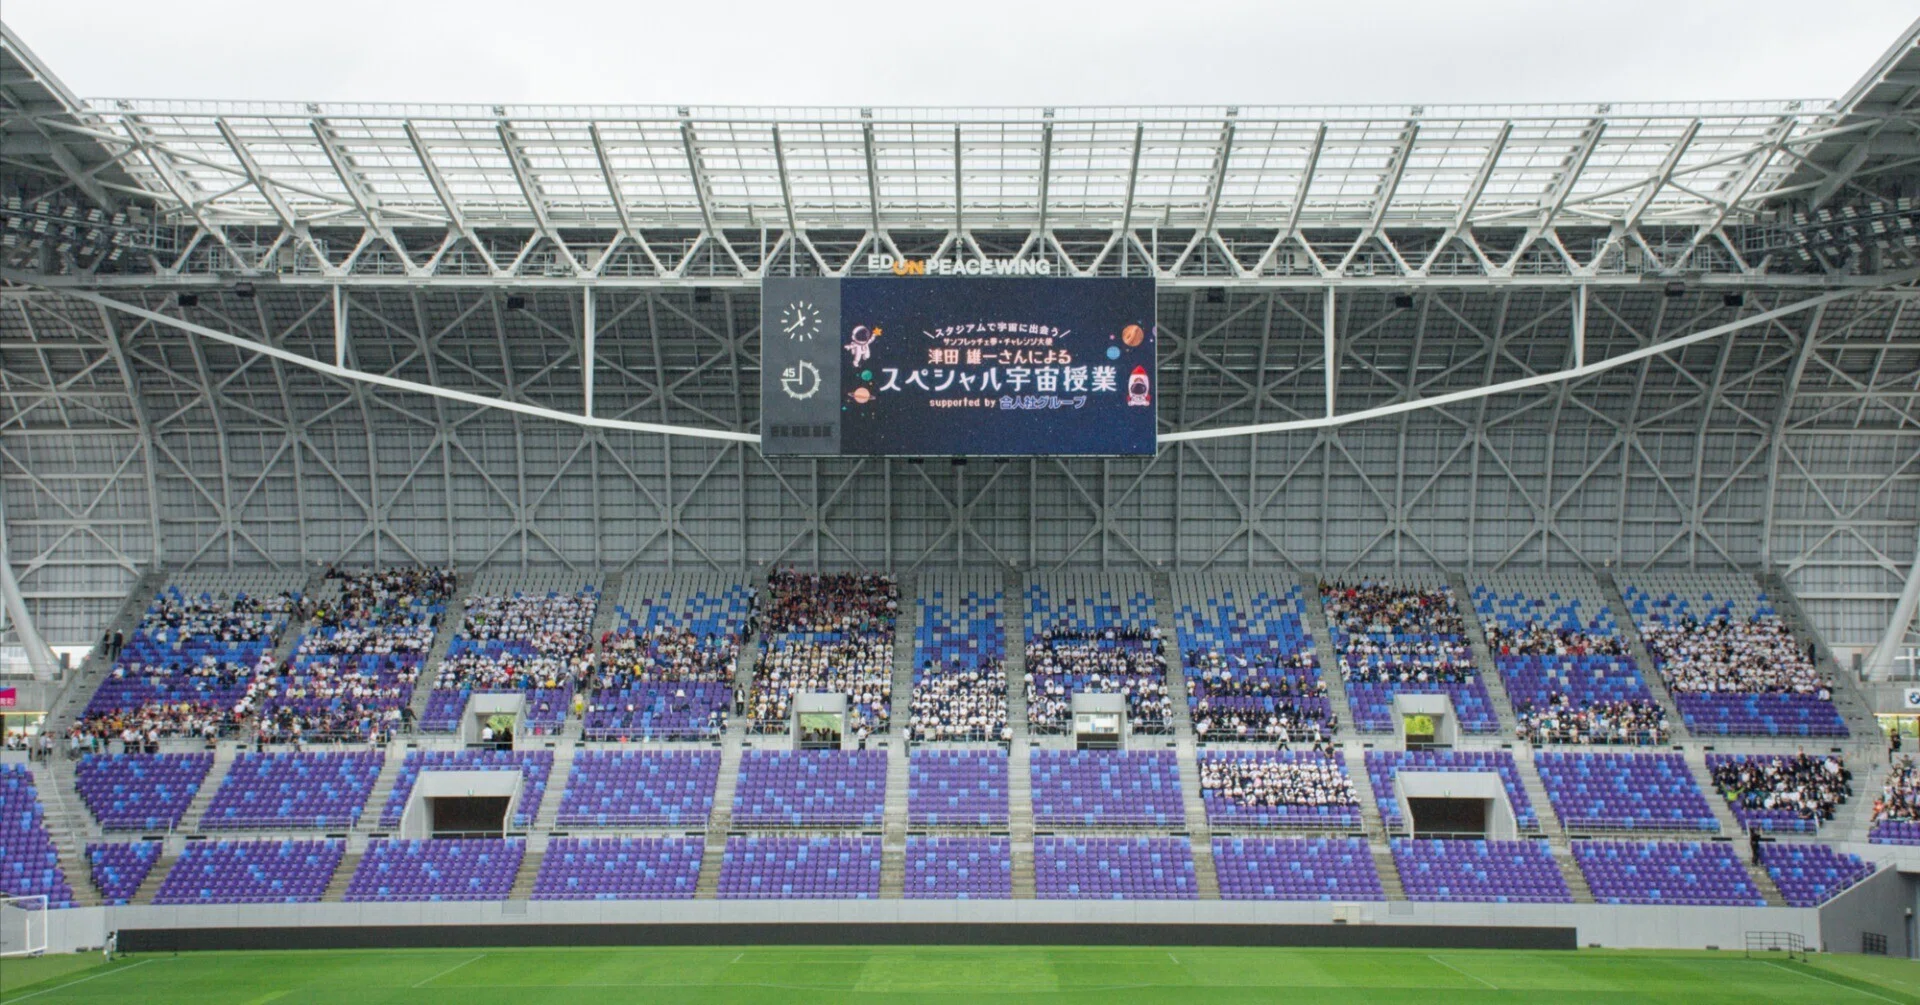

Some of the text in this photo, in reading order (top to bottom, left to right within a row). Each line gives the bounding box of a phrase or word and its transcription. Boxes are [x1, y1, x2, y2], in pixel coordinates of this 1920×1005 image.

[928, 349, 1071, 364] 津田 雄一さんによる
[782, 368, 796, 378] 45
[879, 367, 1117, 392] スペシャル宇宙授業
[929, 395, 1087, 410] supported by 合人社グループ
